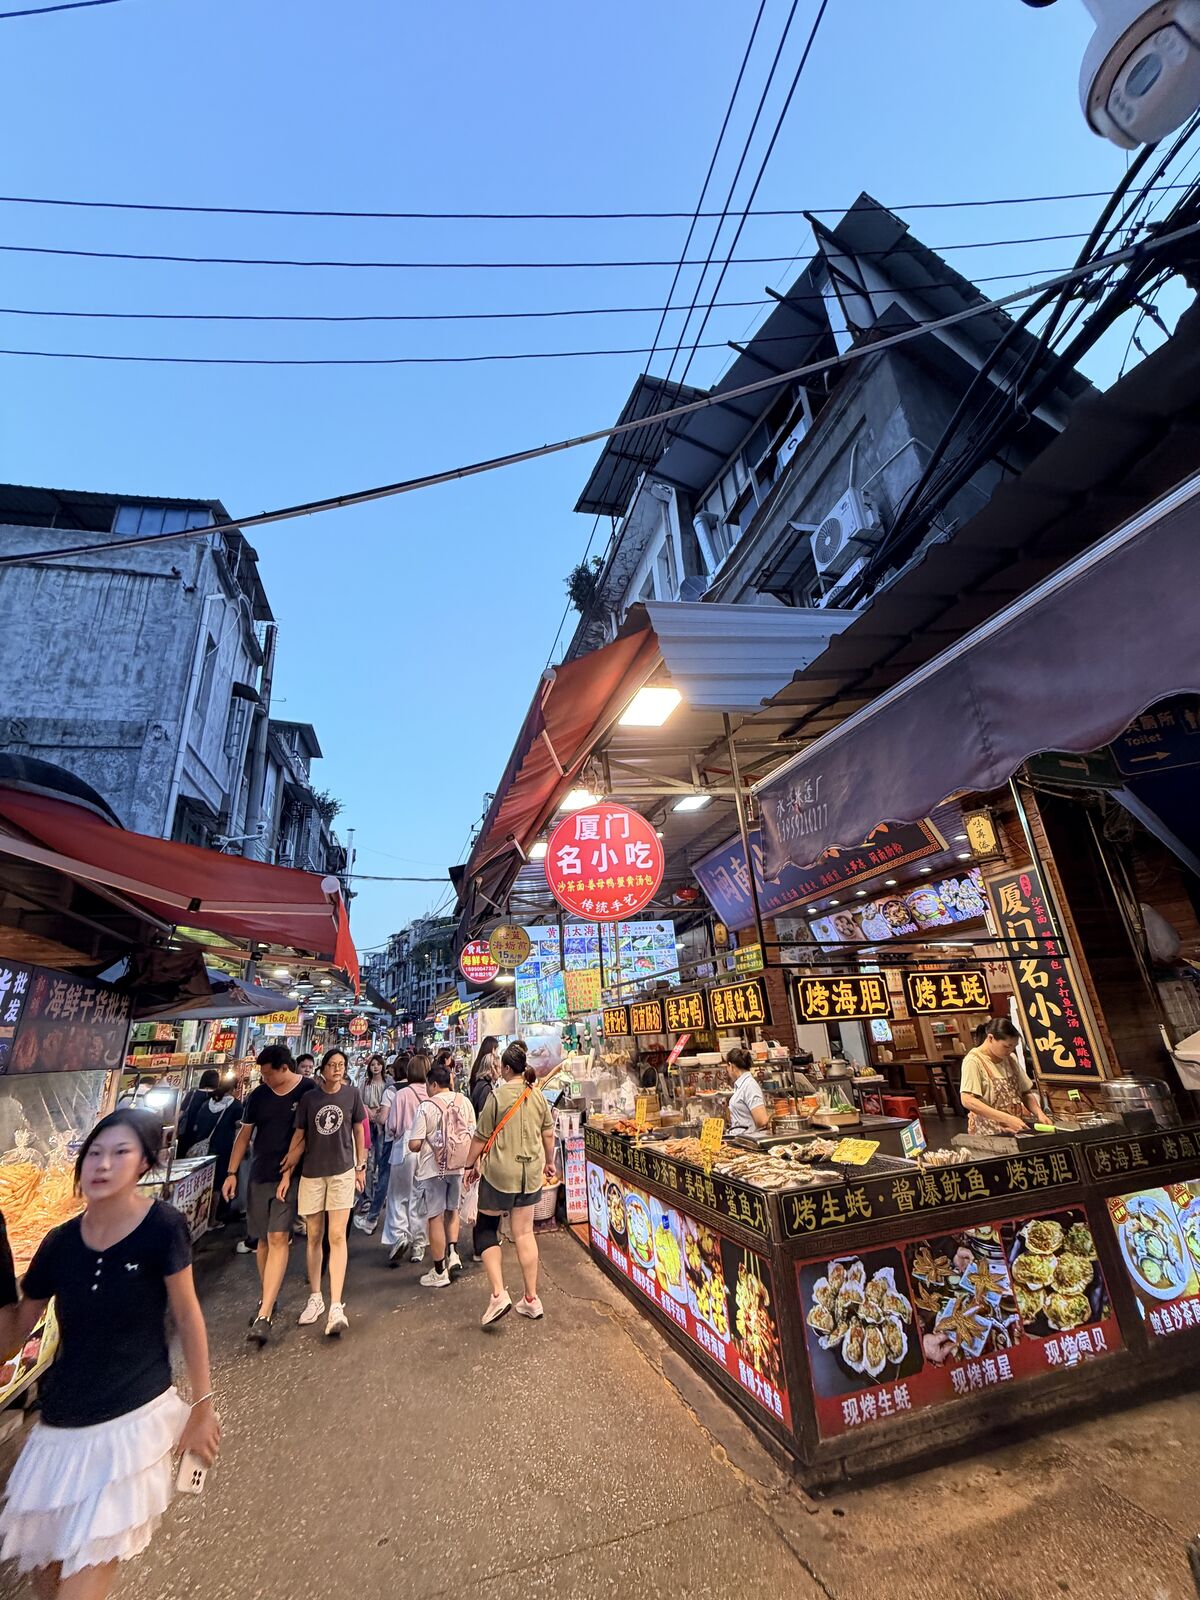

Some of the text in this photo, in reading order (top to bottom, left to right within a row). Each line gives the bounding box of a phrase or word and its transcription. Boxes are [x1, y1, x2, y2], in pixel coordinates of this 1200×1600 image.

[1125, 733, 1163, 747] Toilet
[574, 813, 630, 841] 厦门
[556, 841, 653, 875] 名小吃
[581, 893, 638, 914] 传统手艺
[1031, 896, 1047, 924] 沙茶面
[915, 974, 986, 1009] 烤生蚝
[999, 882, 1076, 1068] 厦门名小吃
[4, 971, 28, 1022] 批发
[44, 979, 130, 1025] 海鲜干货批发
[668, 996, 702, 1028] 姜母鸭
[714, 986, 762, 1023] 酱爆鱿鱼
[805, 979, 886, 1016] 烤海胆
[1056, 976, 1079, 1028] 手打鱼丸汤
[1073, 1036, 1092, 1069] 佛跳墙
[1044, 1327, 1108, 1366] 现烤扇贝
[738, 1358, 784, 1420] 酱爆大鱿鱼
[950, 1354, 1014, 1395] 现烤海星
[841, 1383, 912, 1426] 现烤生蚝
